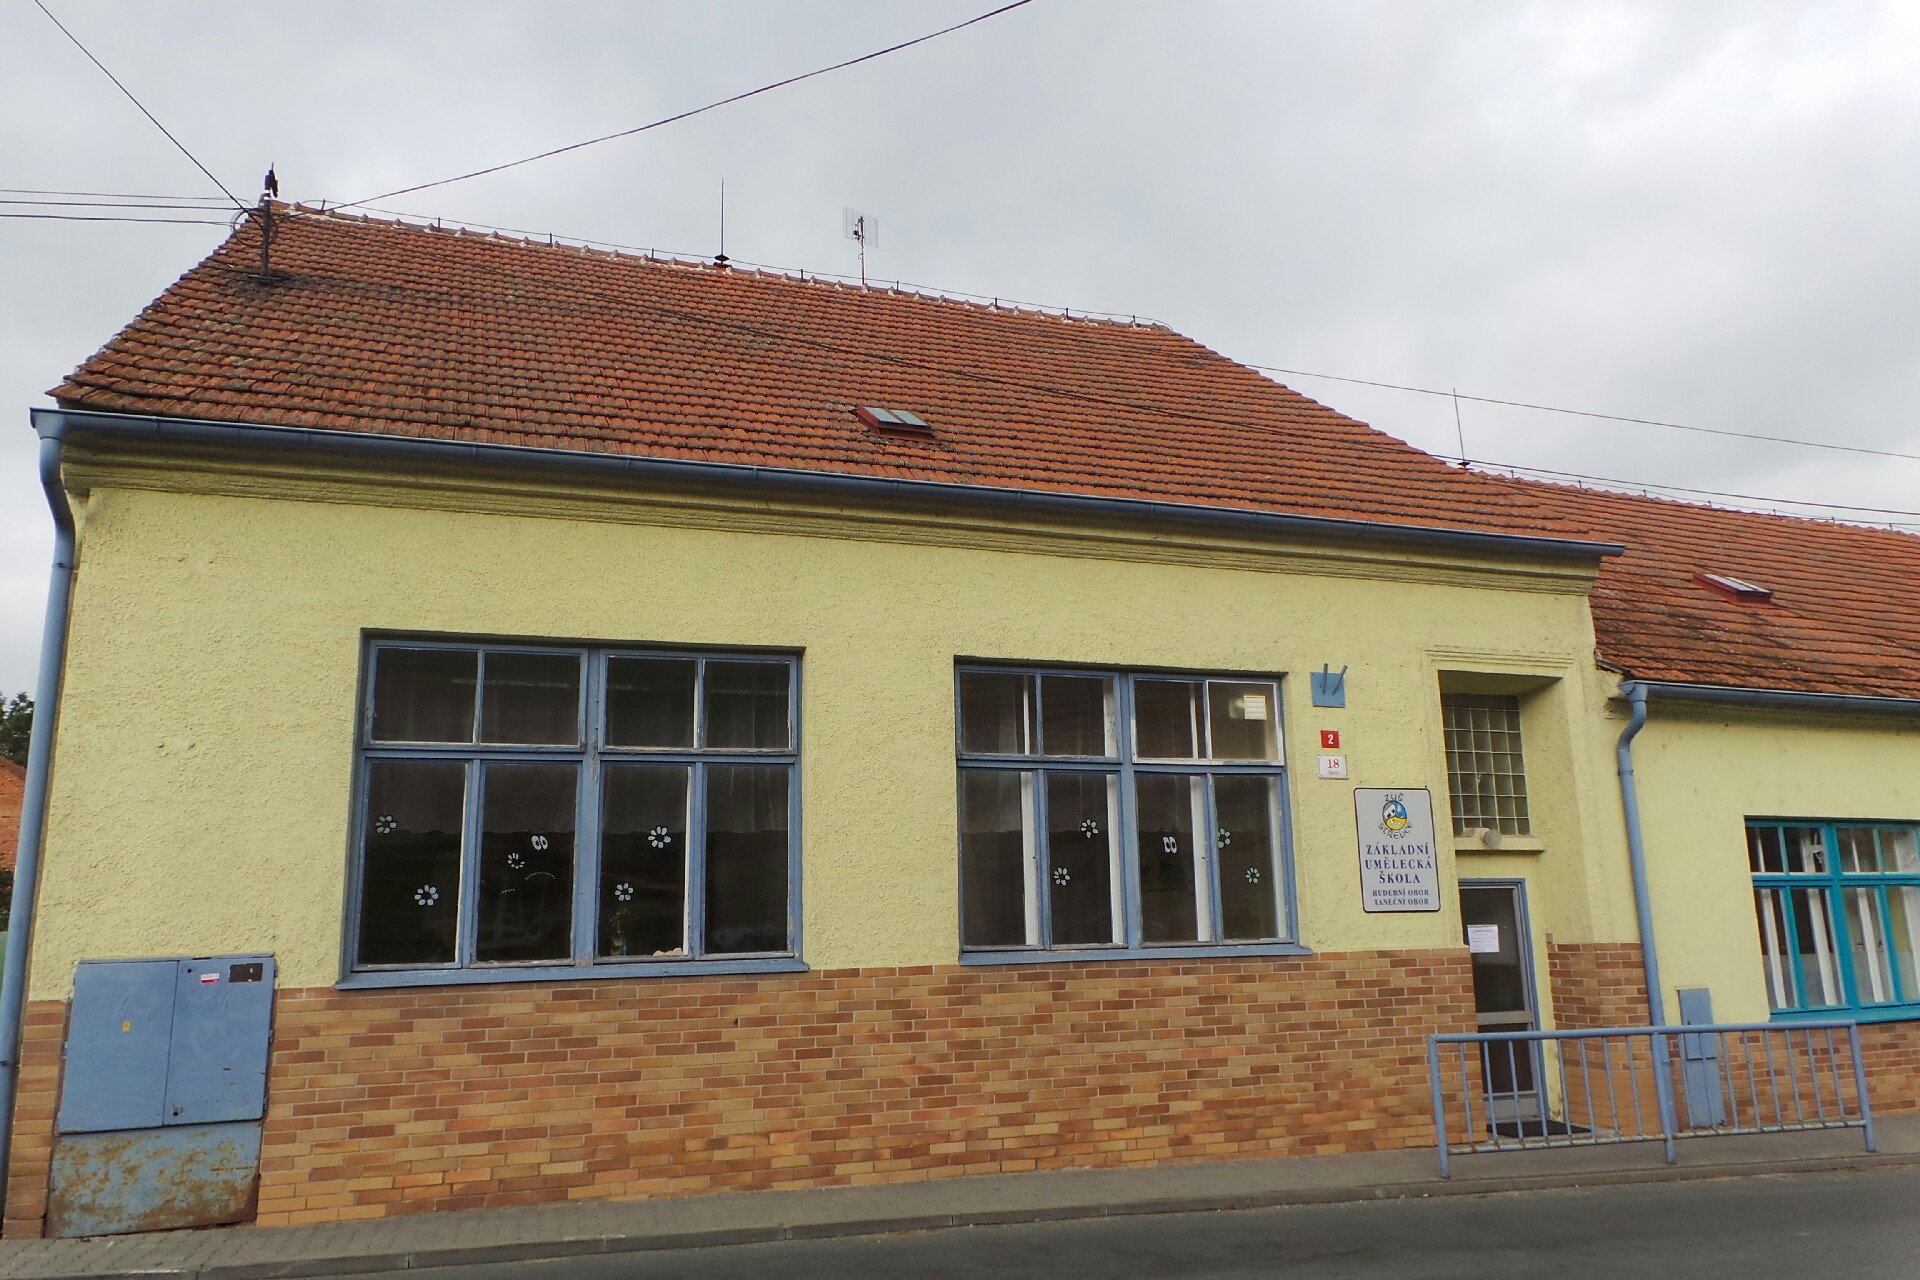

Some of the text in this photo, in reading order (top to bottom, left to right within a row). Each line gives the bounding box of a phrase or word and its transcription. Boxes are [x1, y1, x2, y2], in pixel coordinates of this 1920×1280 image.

[1327, 733, 1334, 745] 2
[1327, 758, 1340, 769] 18
[1384, 792, 1404, 802] ZUŠ
[1366, 842, 1429, 855] ZÁKLADNÍ
[1365, 856, 1432, 870] UMĚLECKÁ
[1379, 871, 1421, 884] ŠKOLA
[1372, 888, 1406, 897] HUDEBNÍ
[1374, 897, 1429, 906] TANEČNÍ OBOR
